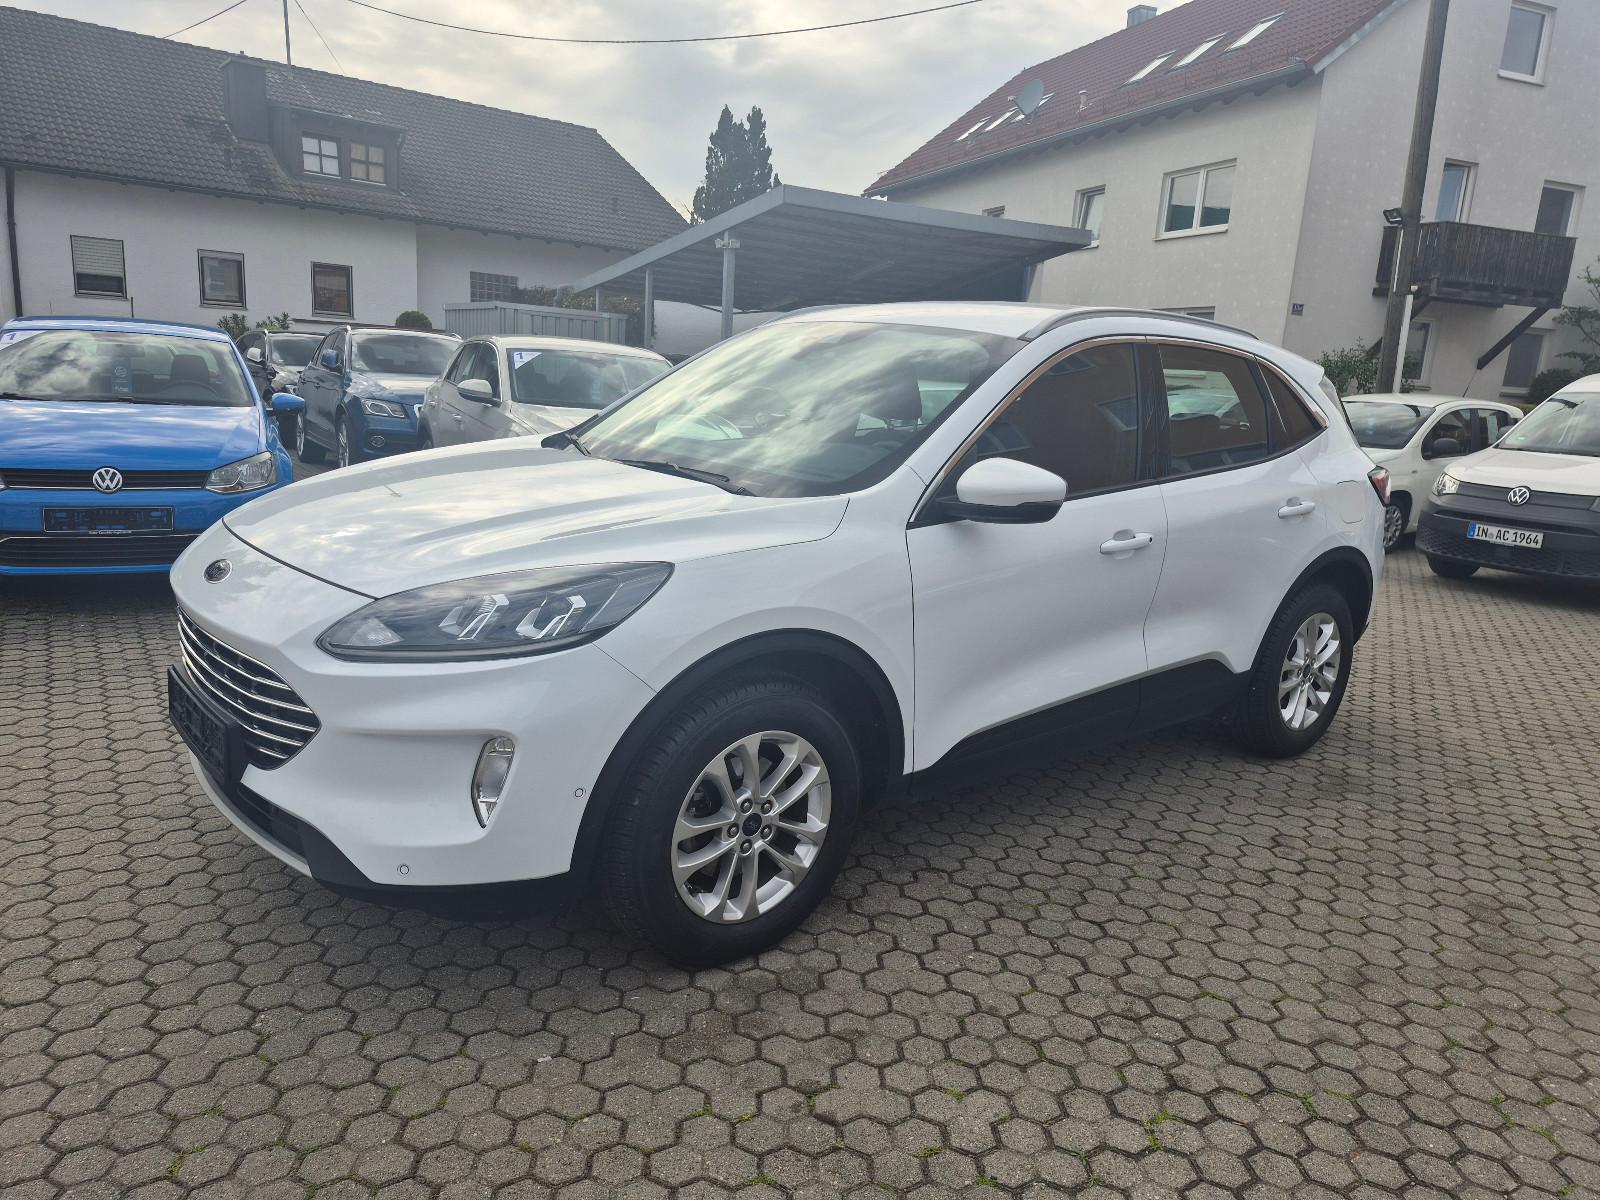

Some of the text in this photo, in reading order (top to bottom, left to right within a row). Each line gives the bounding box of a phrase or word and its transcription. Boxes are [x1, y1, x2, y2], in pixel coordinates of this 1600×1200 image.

[92, 467, 123, 493] VW
[1508, 487, 1530, 505] VW
[1476, 526, 1539, 546] IN AC 1964
